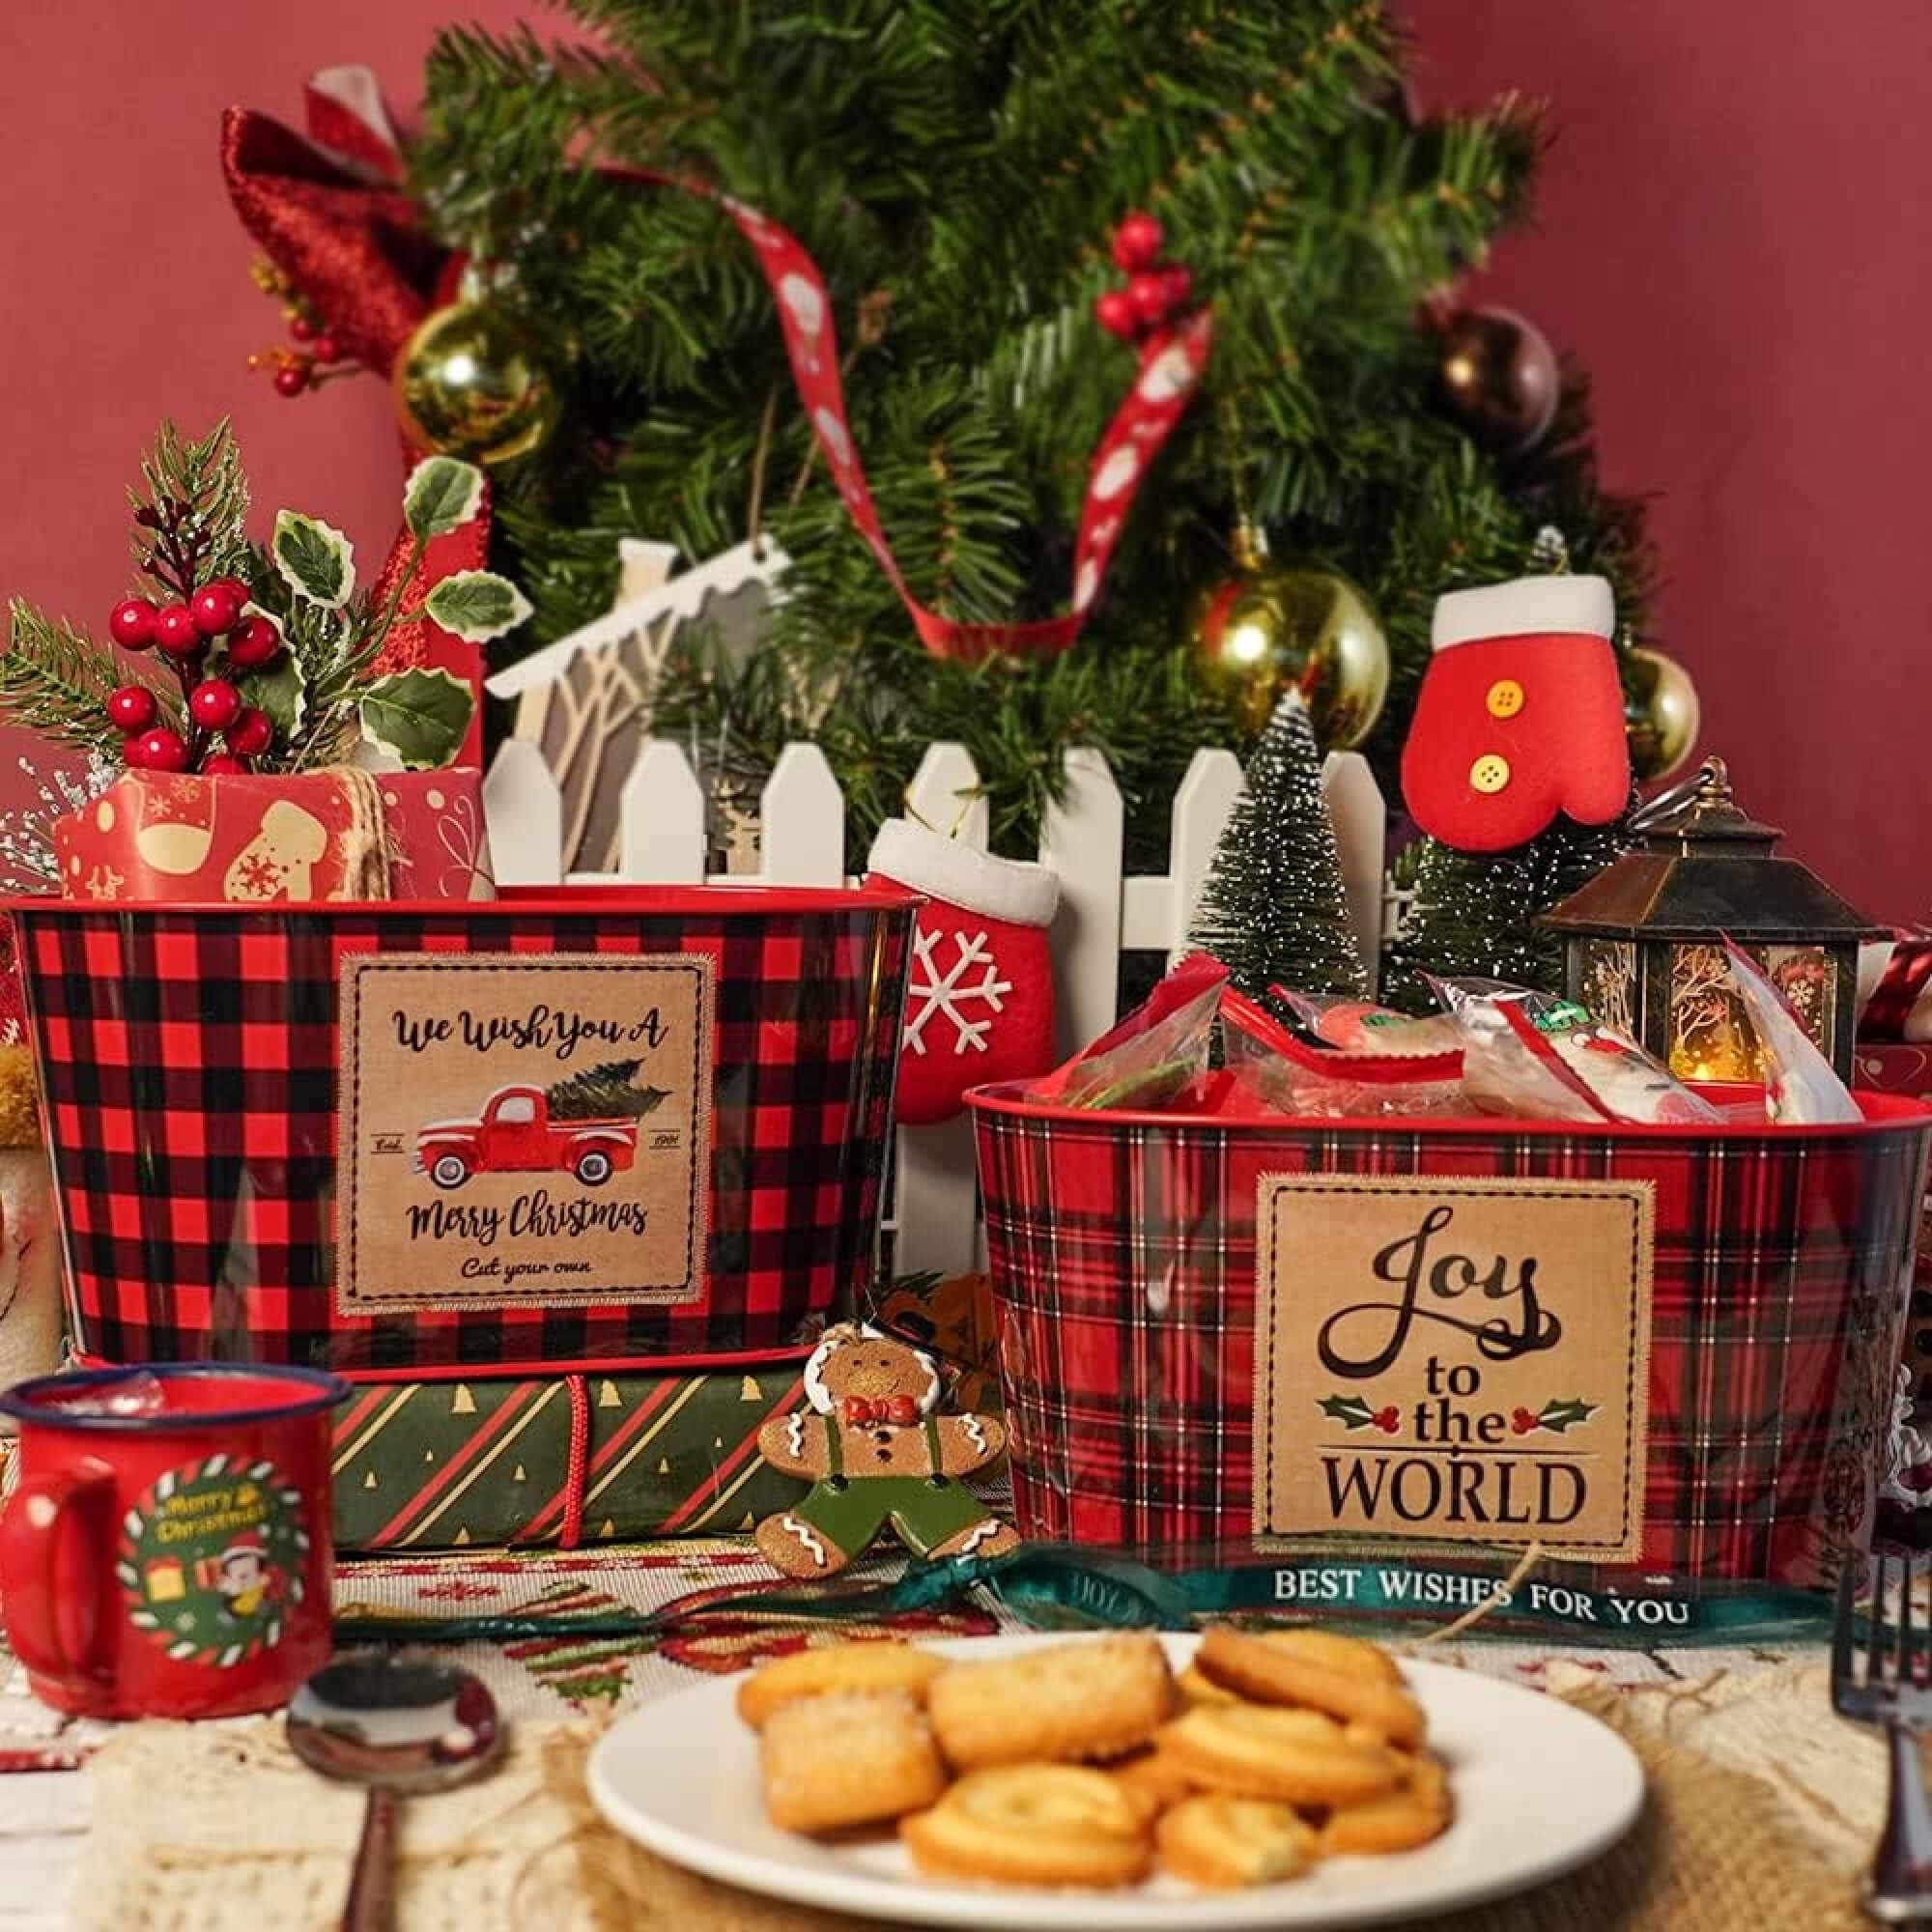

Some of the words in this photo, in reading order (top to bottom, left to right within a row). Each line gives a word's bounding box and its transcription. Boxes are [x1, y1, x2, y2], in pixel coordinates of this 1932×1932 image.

[392, 1009, 453, 1052] We
[458, 1005, 553, 1052] Wish
[553, 1011, 625, 1060] You
[629, 1008, 668, 1048] A
[406, 1199, 504, 1246] Merry
[509, 1189, 647, 1237] Christmas
[461, 1257, 500, 1278] Cut
[502, 1264, 551, 1284] your
[554, 1263, 592, 1273] own
[1318, 1206, 1562, 1379] Joy
[1424, 1356, 1481, 1396] to
[1413, 1398, 1507, 1443] the
[1321, 1457, 1587, 1524] WORLD
[1273, 1569, 1362, 1600] BEST
[1378, 1570, 1513, 1606] WISHES
[1529, 1583, 1598, 1621] FOR
[1609, 1599, 1689, 1624] YOU
